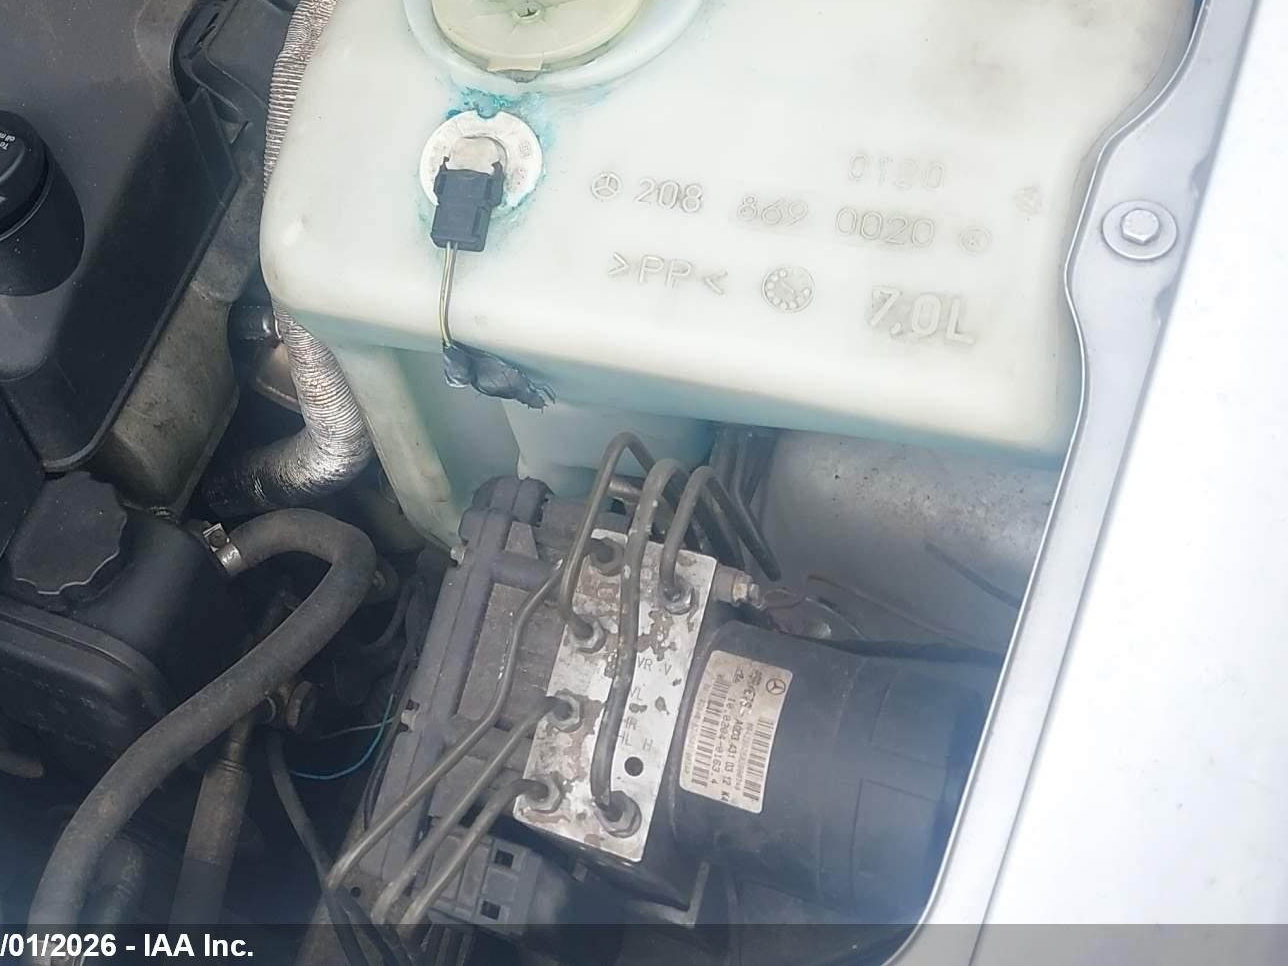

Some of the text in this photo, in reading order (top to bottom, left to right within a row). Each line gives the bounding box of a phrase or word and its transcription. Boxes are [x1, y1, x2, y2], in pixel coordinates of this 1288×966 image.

[0, 141, 10, 150] To
[632, 177, 935, 249] 208 869 0020
[637, 655, 653, 672] VR
